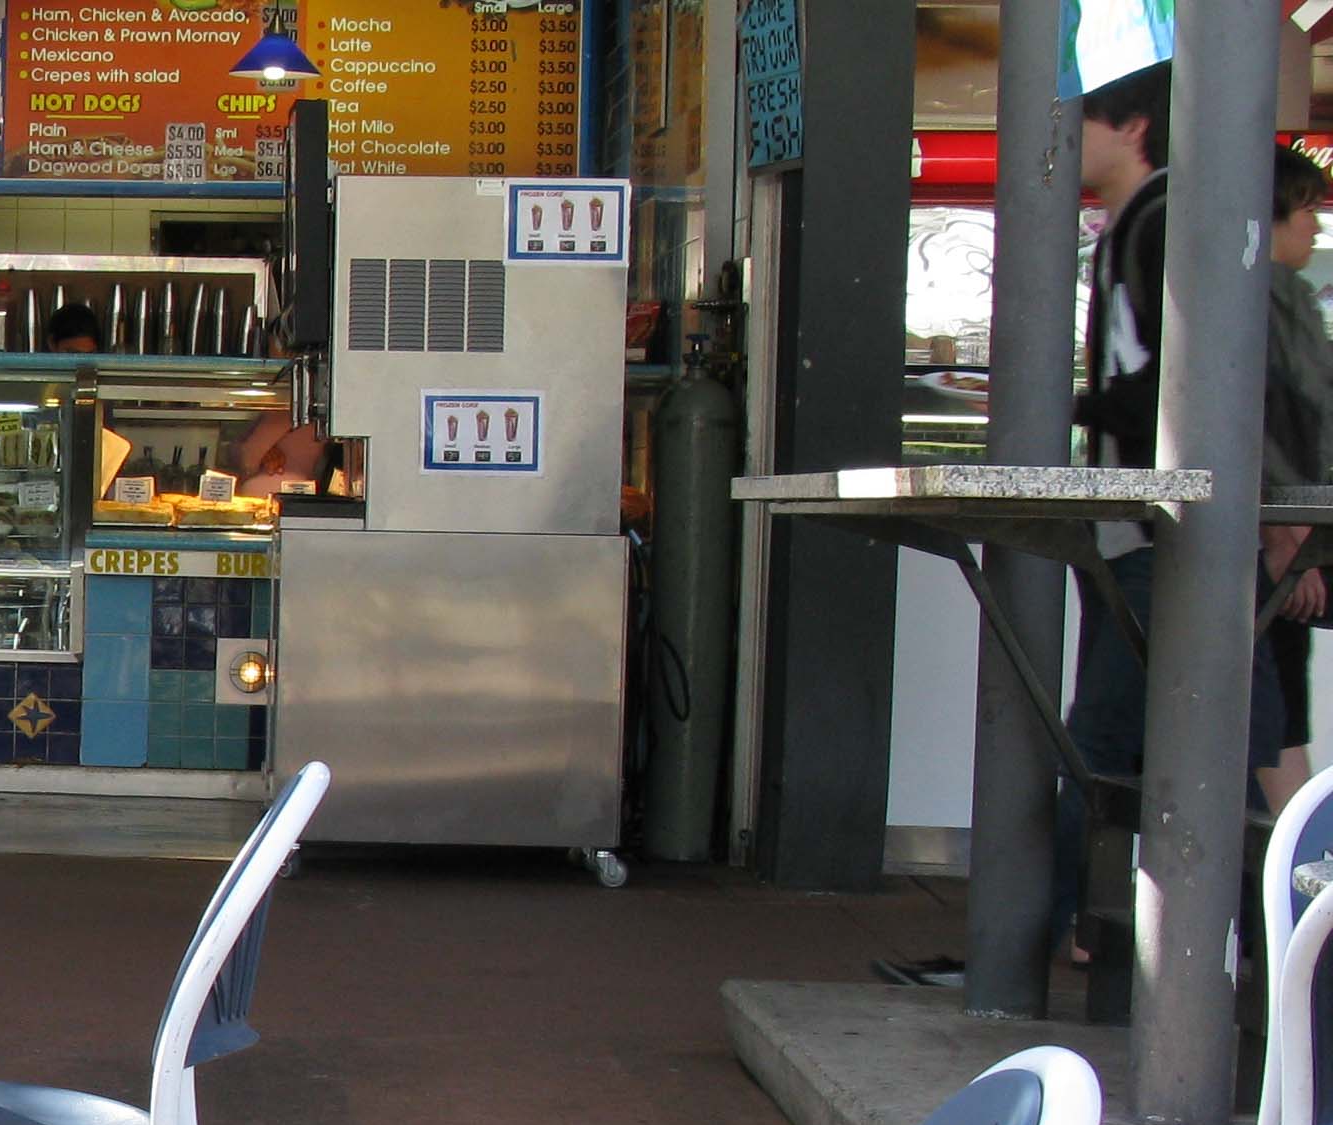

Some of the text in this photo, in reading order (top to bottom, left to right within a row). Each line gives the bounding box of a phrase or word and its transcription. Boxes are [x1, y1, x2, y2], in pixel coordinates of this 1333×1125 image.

[474, 2, 507, 13] Small
[538, 2, 573, 14] Large
[32, 8, 250, 24] Ham, Chicken & Avocado,
[331, 18, 391, 32] Mocha
[471, 18, 508, 34] $3.00
[539, 18, 577, 34] $3.50
[32, 28, 241, 46] Chicken & Prawn Mornay
[331, 38, 371, 52] Latte
[471, 38, 507, 53] $3.00
[539, 38, 575, 54] $3.50
[31, 48, 114, 62] Mexicano
[331, 58, 436, 76] Cappuccino
[470, 60, 507, 74] $3.00
[539, 60, 575, 76] $3.50
[31, 68, 180, 86] Crepes with salad
[329, 78, 387, 94] Coffee
[469, 80, 507, 95] $2.50
[538, 80, 575, 96] $3.00
[747, 78, 799, 112] FRESH
[31, 94, 141, 112] HOT DOGS
[217, 94, 277, 112] CHIPS
[330, 99, 359, 112] Tea
[469, 100, 506, 115] $2.50
[538, 101, 574, 116] $3.00
[29, 122, 67, 138] Plain
[169, 126, 204, 140] $4.00
[215, 127, 237, 138] Sml
[328, 120, 394, 134] Hot Milo
[469, 120, 505, 135] $3.00
[537, 121, 574, 136] $3.50
[29, 142, 155, 156] Ham & Cheese
[167, 144, 203, 160] $5.50
[214, 146, 244, 156] Med
[327, 140, 451, 154] Hot Chocolate
[469, 140, 505, 156] $3.00
[537, 142, 573, 156] $3.50
[29, 160, 162, 176] Dagwood Dogs
[361, 160, 407, 174] White
[469, 161, 505, 176] $3.00
[536, 162, 573, 176] $3.50
[89, 550, 180, 574] CREPES
